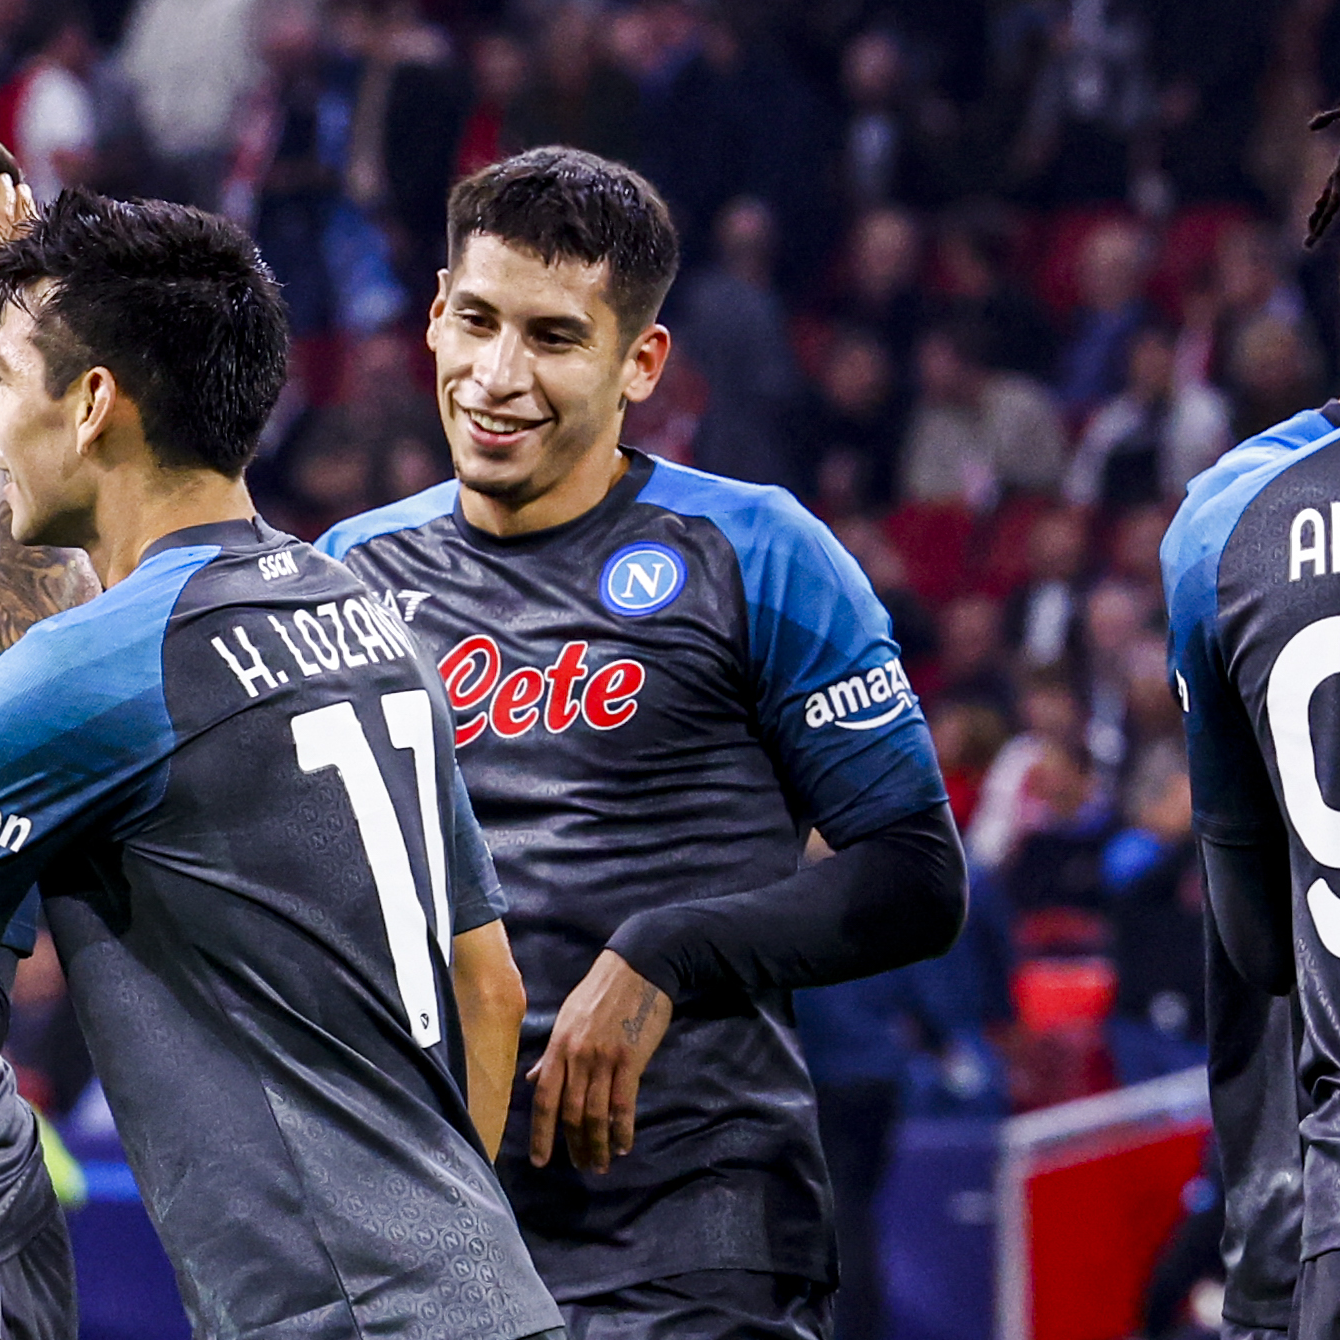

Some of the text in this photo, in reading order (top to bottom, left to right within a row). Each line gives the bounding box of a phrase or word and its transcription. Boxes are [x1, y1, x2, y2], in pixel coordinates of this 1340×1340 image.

[258, 550, 299, 581] SSCN
[210, 596, 418, 698] H. LOZAN
[290, 689, 452, 1049] 11
